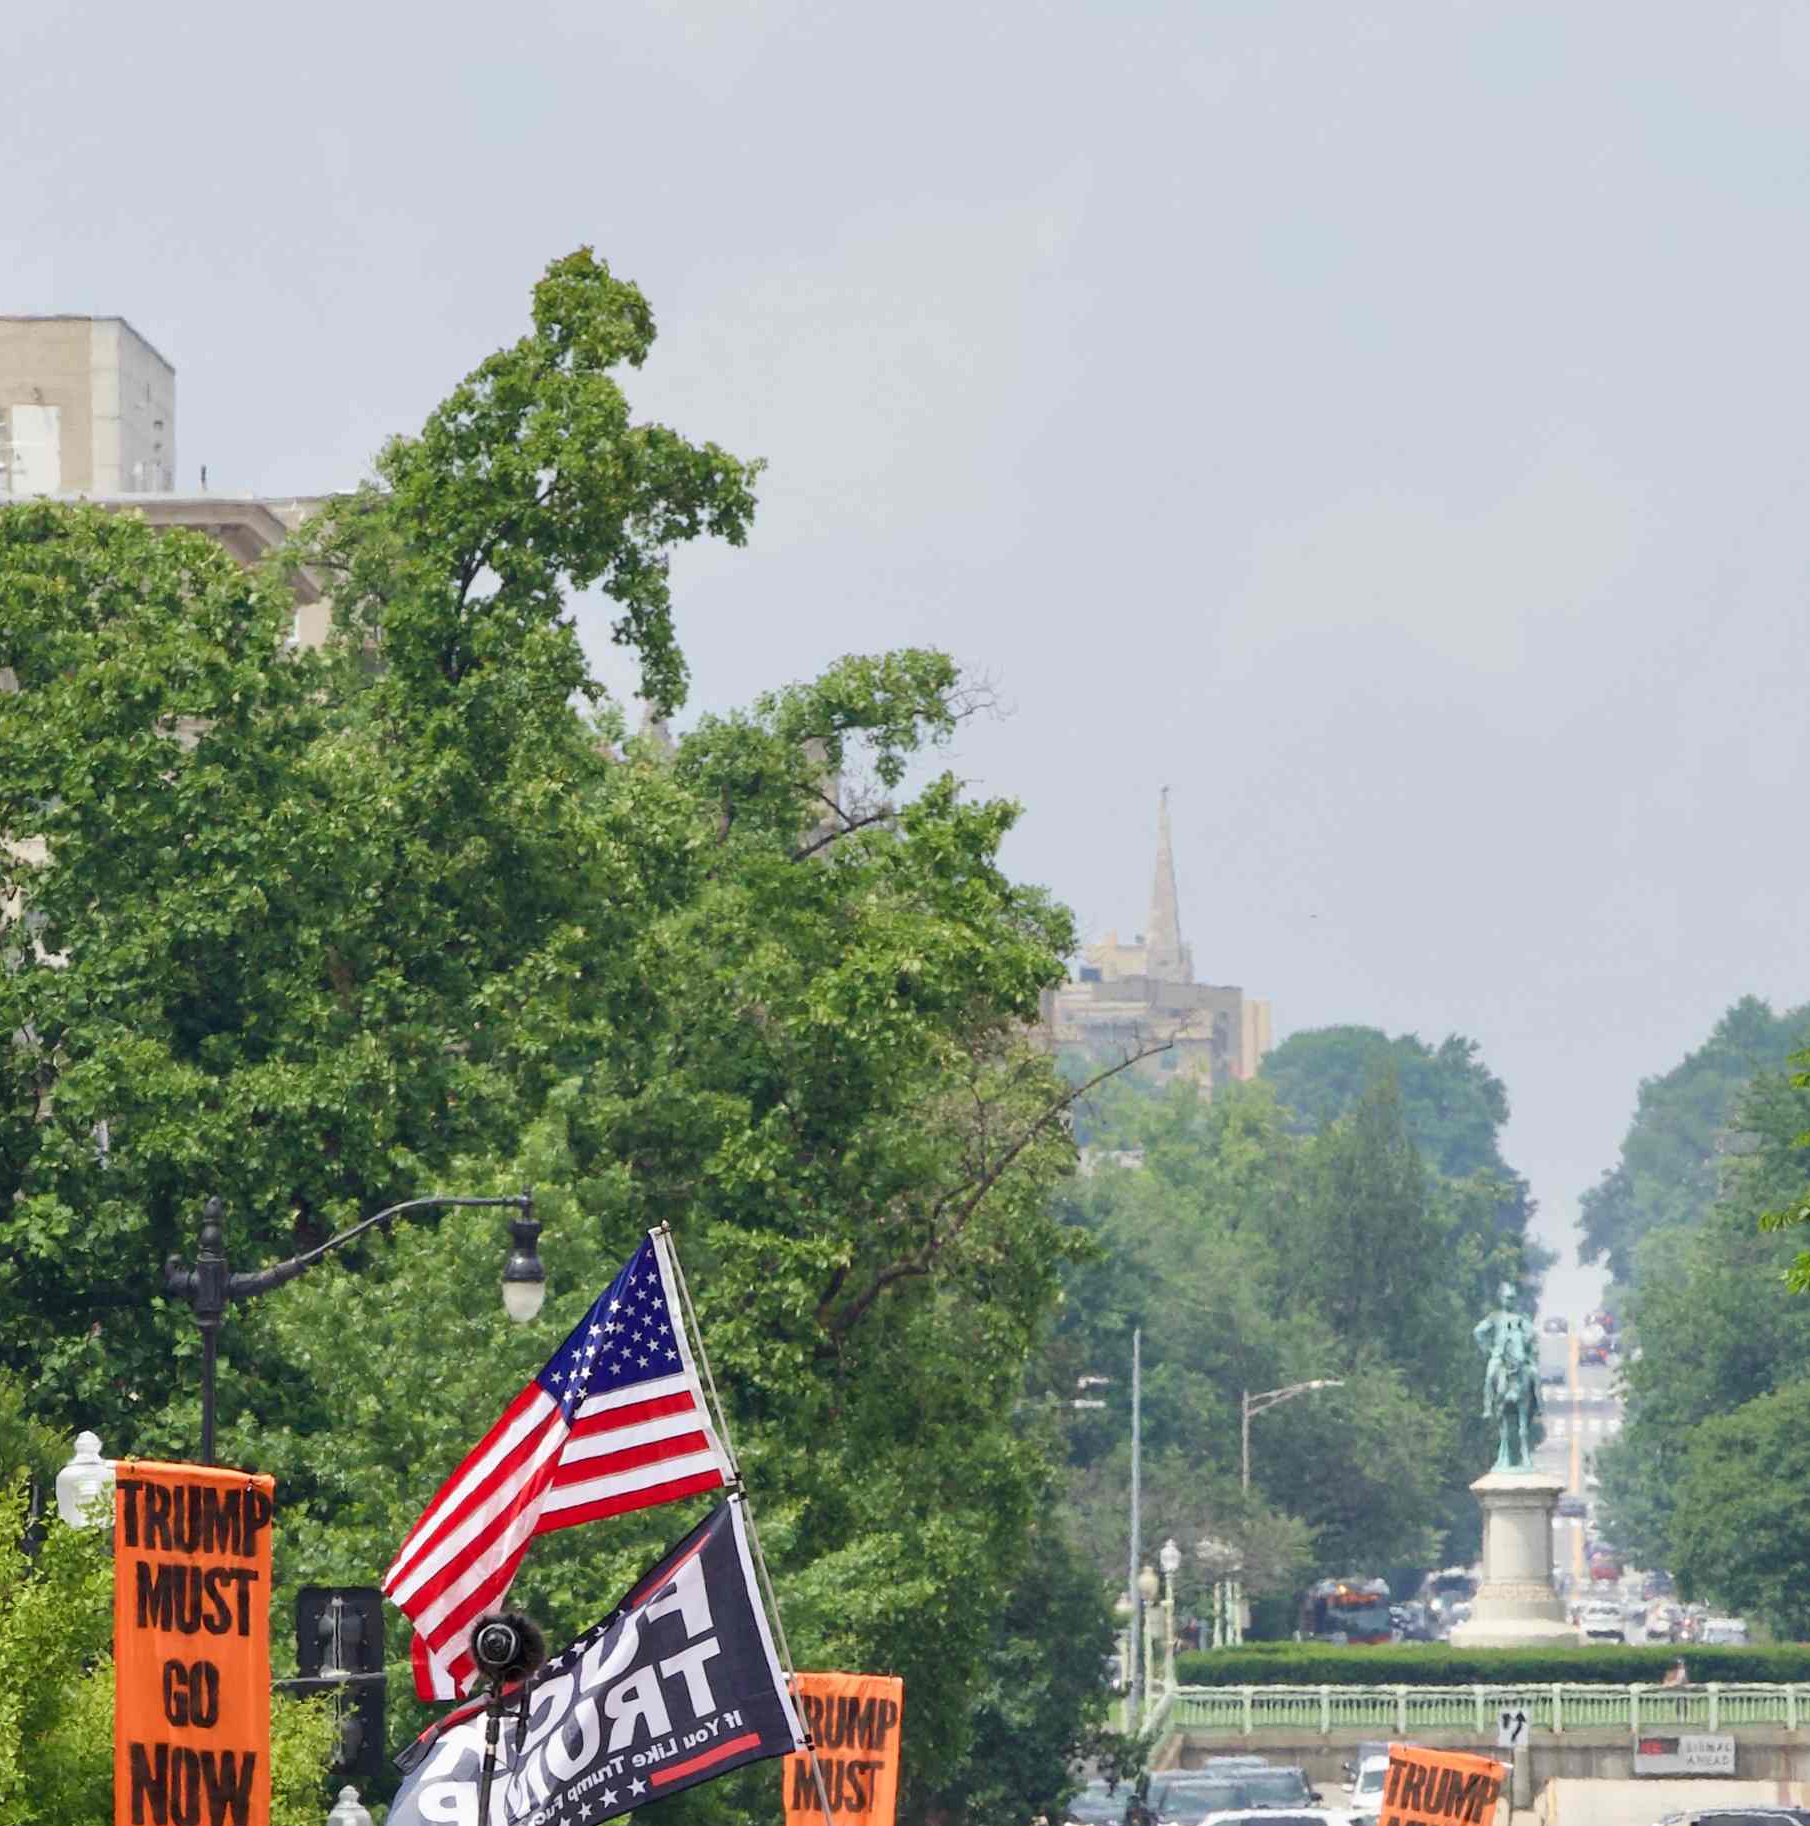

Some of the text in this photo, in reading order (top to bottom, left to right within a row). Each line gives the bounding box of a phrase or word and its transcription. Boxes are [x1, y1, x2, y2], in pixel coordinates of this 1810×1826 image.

[116, 1478, 274, 1558] TRUMP
[135, 1561, 259, 1637] MUST
[163, 1659, 220, 1728] GO
[792, 1758, 885, 1813] MUST
[1386, 1756, 1501, 1824] TRUMP
